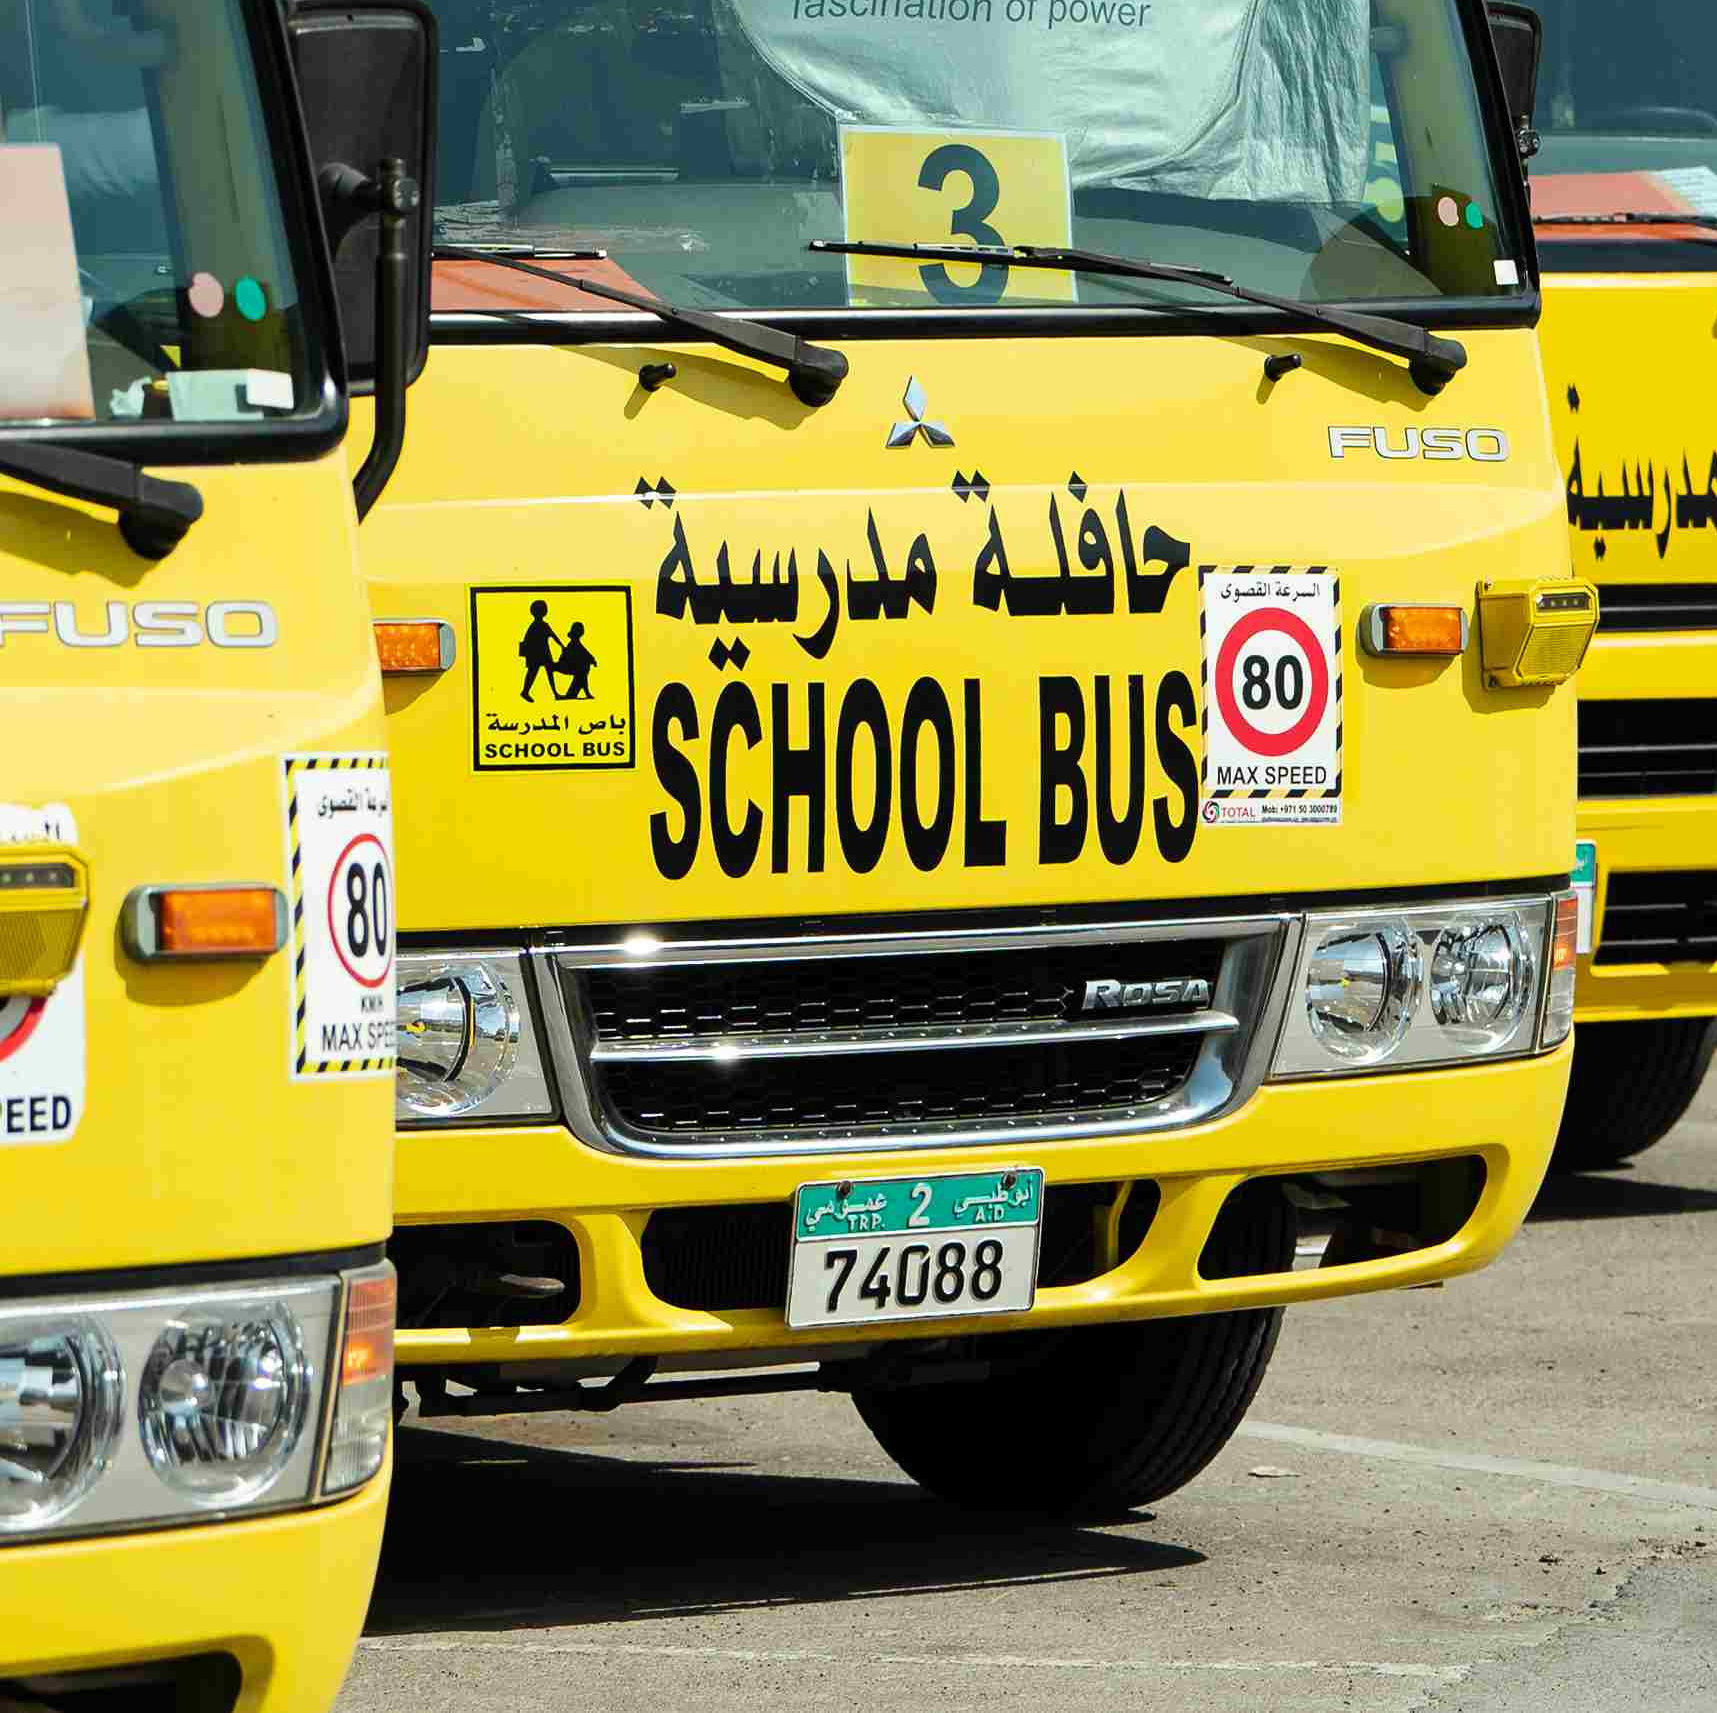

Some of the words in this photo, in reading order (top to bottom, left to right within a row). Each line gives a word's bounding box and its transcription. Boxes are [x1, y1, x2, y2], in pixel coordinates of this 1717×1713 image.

[917, 144, 1009, 304] 3
[1328, 425, 1509, 462] FUSO
[951, 470, 1191, 617] حافلة
[634, 476, 938, 672] مدرسية
[0, 600, 278, 648] FUSO
[1243, 655, 1304, 710] 80
[485, 712, 569, 735] المدرسة
[578, 714, 626, 735] باص
[485, 743, 575, 759] SCHOOL
[583, 742, 625, 757] BUS
[650, 676, 1007, 880] SCHOOL
[1039, 670, 1200, 866] BUS
[1217, 766, 1259, 785] MAX
[1265, 766, 1327, 785] SPEED
[1221, 806, 1257, 818] TOTAL
[346, 861, 388, 958] 80
[322, 1023, 363, 1053] MAX
[0, 1094, 73, 1136] EED
[907, 1182, 933, 1228] 2
[824, 1238, 1004, 1313] 74088
